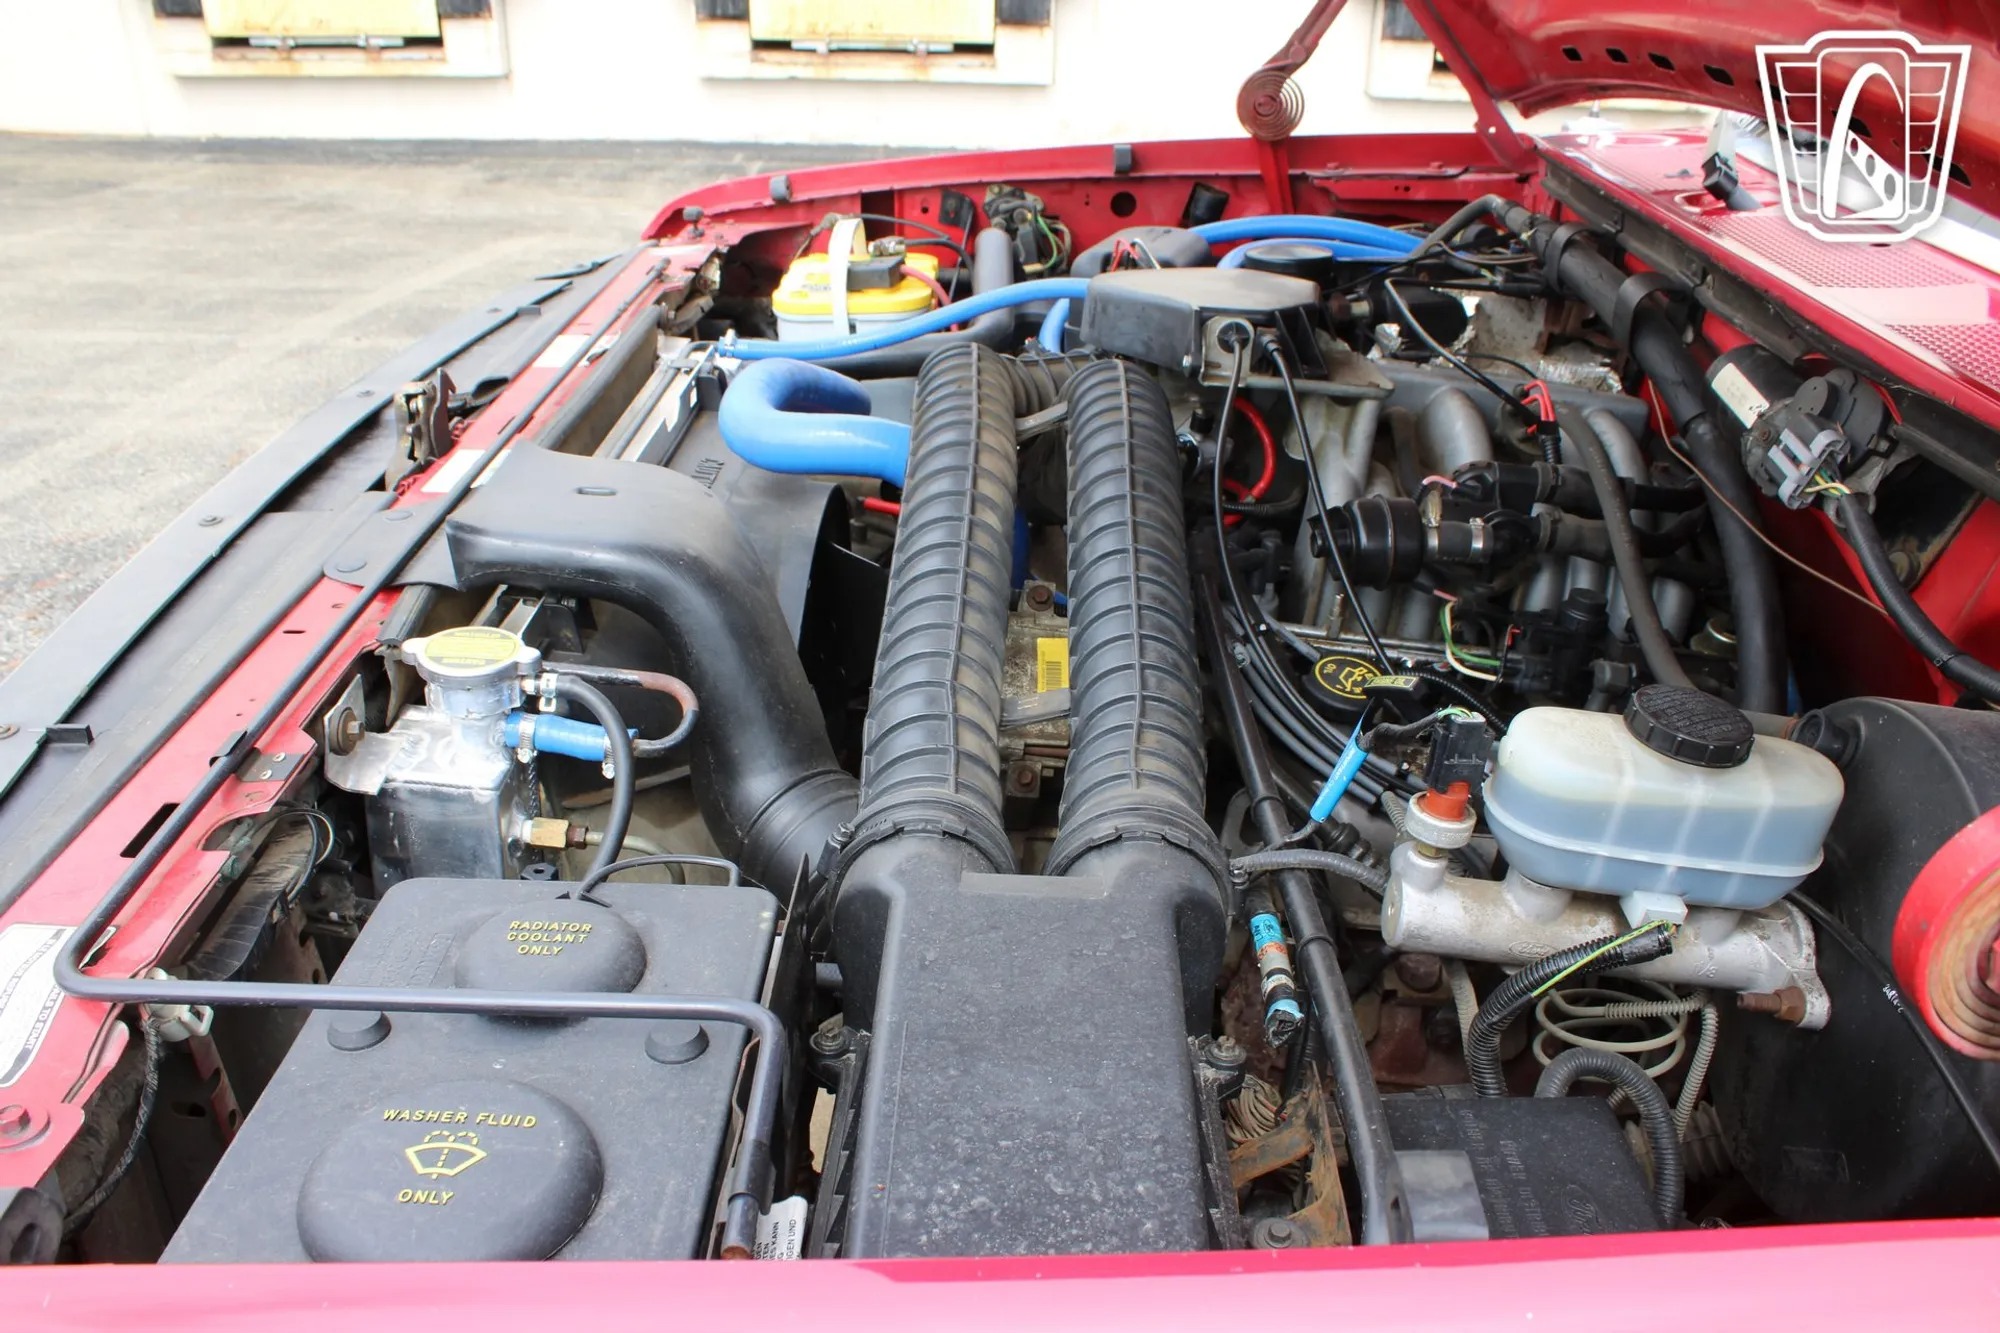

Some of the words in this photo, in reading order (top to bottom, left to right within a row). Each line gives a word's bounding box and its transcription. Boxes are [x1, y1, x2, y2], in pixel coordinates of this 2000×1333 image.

[509, 920, 593, 934] RADIATOR
[507, 931, 588, 943] COOLANT
[517, 944, 564, 955] ONLY
[383, 1108, 468, 1124] WASHER
[476, 1112, 537, 1128] FLUID
[398, 1188, 455, 1205] ONLY
[788, 1219, 797, 1238] UND
